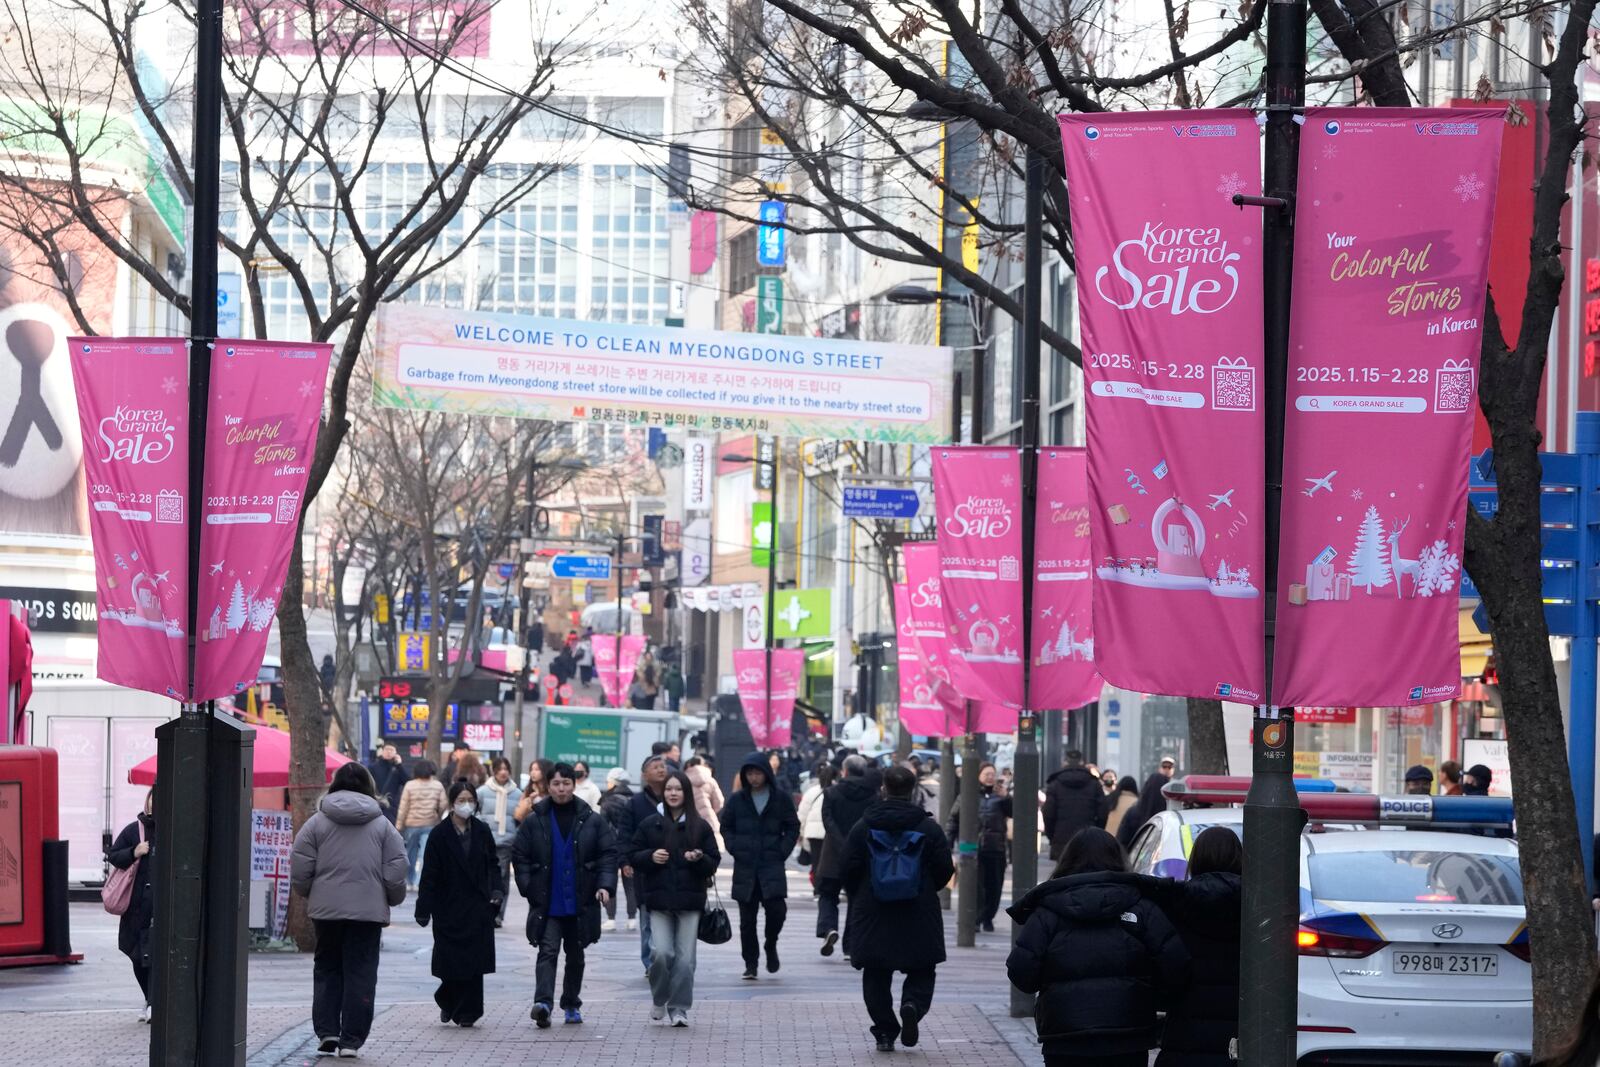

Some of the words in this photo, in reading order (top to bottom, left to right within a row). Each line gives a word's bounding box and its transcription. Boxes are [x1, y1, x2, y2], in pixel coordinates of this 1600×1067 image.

[1141, 221, 1221, 246] Korea
[1326, 231, 1357, 248] Your
[1147, 240, 1227, 263] Grand
[1330, 243, 1432, 281] Colorful
[1095, 239, 1241, 315] Sale
[1387, 281, 1462, 317] Stories
[1426, 322, 1440, 336] in
[1441, 317, 1478, 334] Korea
[454, 323, 554, 346] WELCOME
[563, 333, 588, 349] TO
[597, 335, 661, 354] CLEAN
[669, 341, 805, 364] MYEONGDONG
[813, 352, 885, 370] STREET
[497, 356, 520, 371] 명동
[525, 358, 571, 375] 거리가게
[576, 363, 621, 378] 쓰레기는
[625, 367, 648, 381] 주변
[653, 369, 708, 385] 거리가게로
[712, 373, 746, 387] 주시면
[750, 377, 794, 391] 수거하여
[798, 379, 842, 394] 드립니다
[1091, 353, 1205, 379] 2025..15-2.28
[406, 366, 455, 381] Garbage
[459, 369, 485, 383] from
[488, 374, 559, 391] Myeongdong
[563, 379, 595, 392] street
[599, 383, 627, 394] store
[629, 385, 647, 396] will
[650, 386, 663, 397] be
[666, 388, 716, 400] collected
[719, 390, 728, 401] if
[730, 393, 750, 404] you
[752, 393, 776, 406] give
[778, 394, 786, 405] it
[789, 395, 801, 407] to
[803, 395, 821, 408] the
[823, 399, 859, 412] nearby
[862, 401, 893, 413] street
[895, 403, 923, 415] store
[1166, 395, 1183, 403] SALE
[114, 405, 163, 421] Korea
[1333, 400, 1358, 408] KOREA
[1386, 401, 1404, 409] SALE
[118, 418, 168, 433] Grand
[224, 414, 242, 425] Your
[94, 416, 175, 464] Sale
[225, 420, 282, 445] Colorful
[254, 443, 297, 464] Stories
[274, 467, 282, 476] in
[283, 465, 305, 476] Korea
[692, 443, 704, 504] SUSHIRO
[967, 495, 1003, 506] Korea
[944, 503, 1012, 539] Sale
[1424, 684, 1457, 695] UnionPay
[1384, 802, 1430, 813] POLICE
[1400, 955, 1444, 971] 998마
[1449, 955, 1491, 973] 2317
